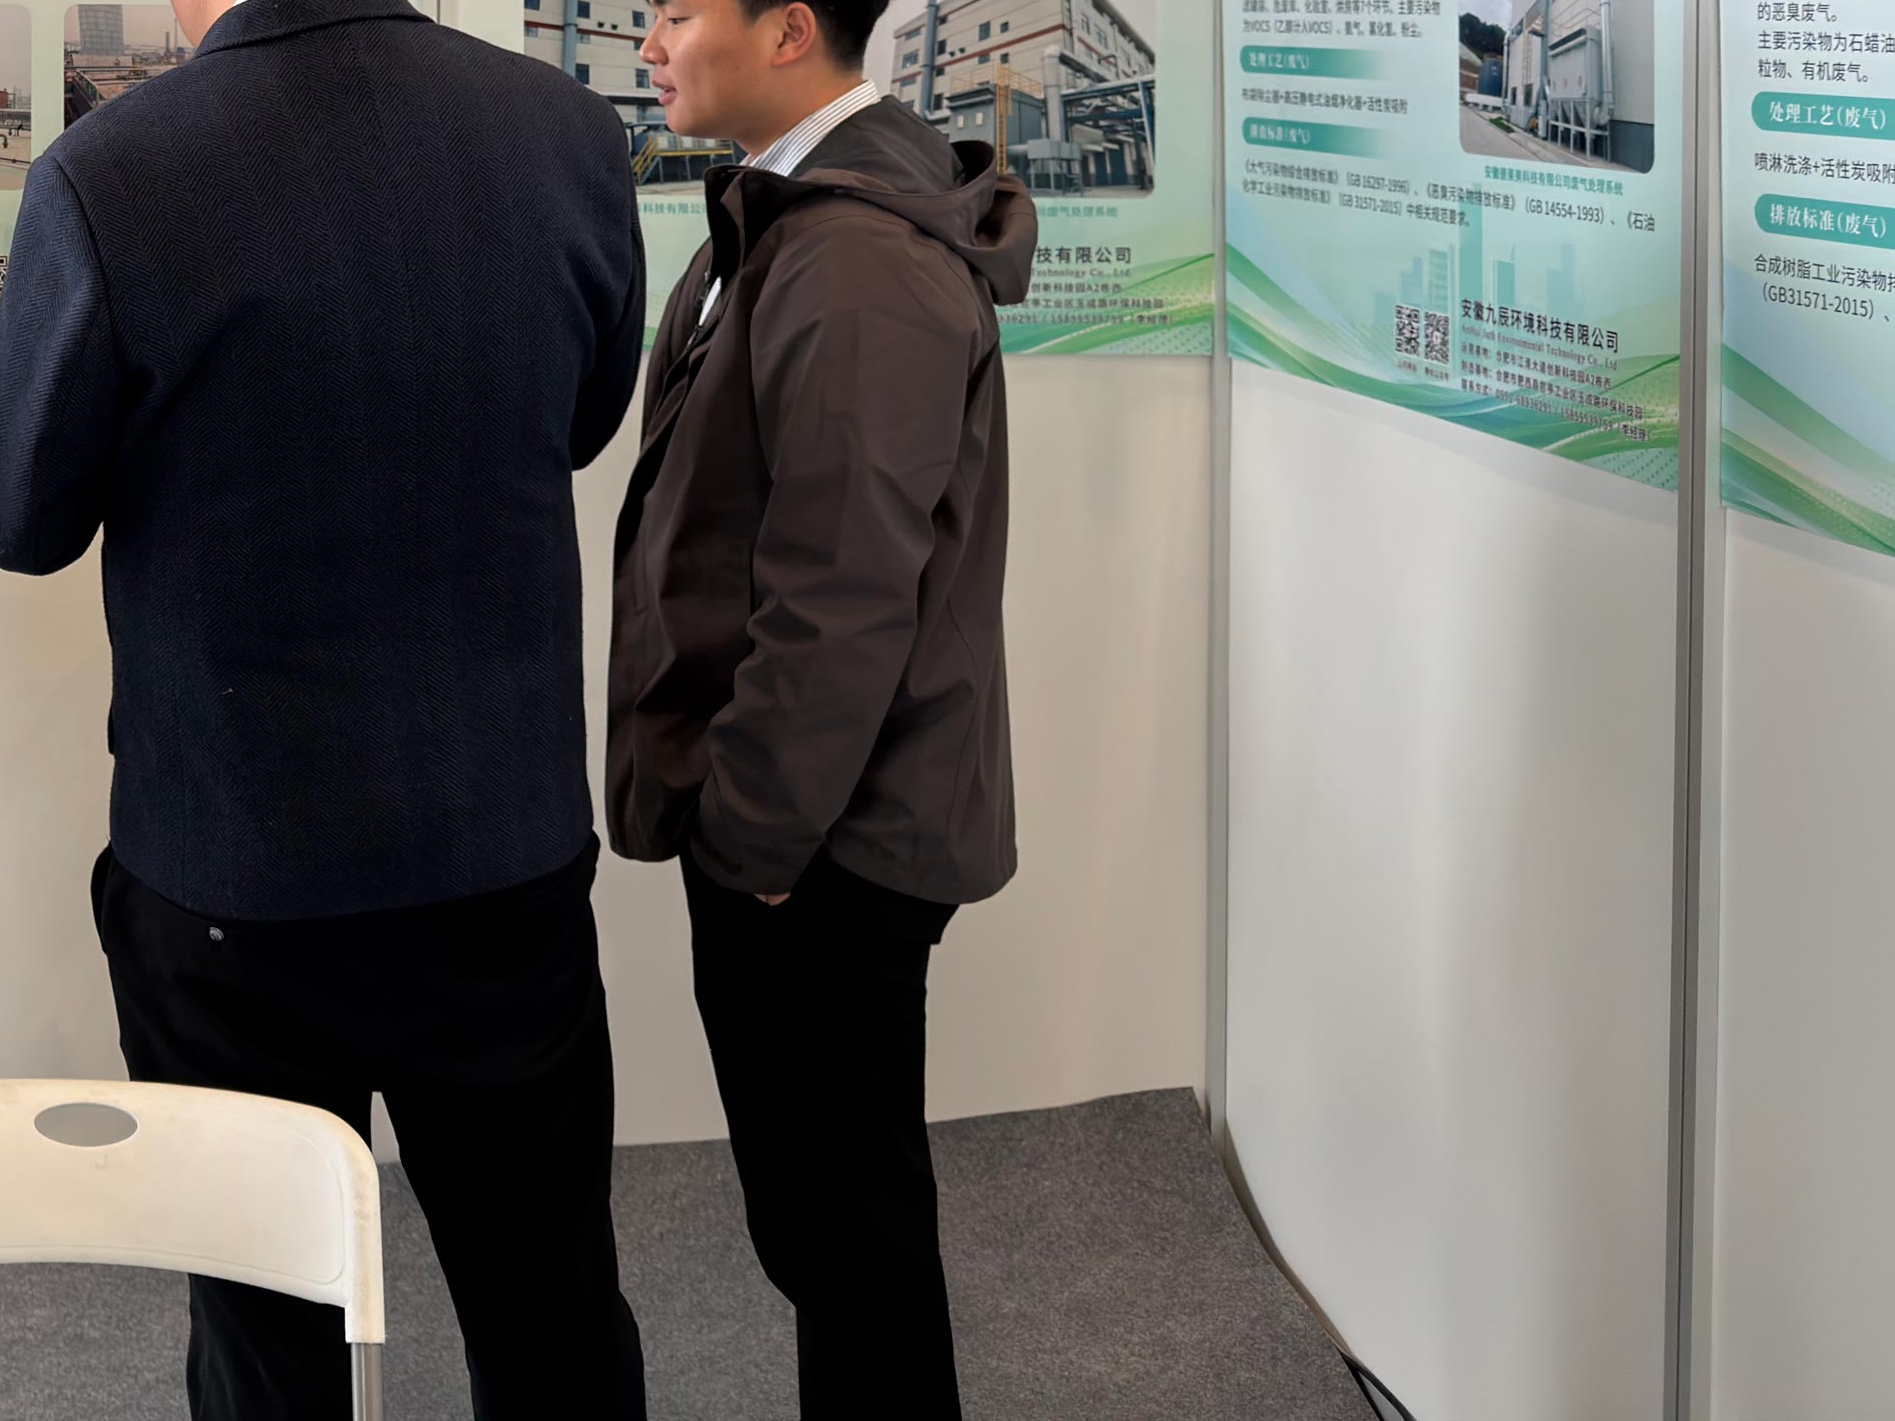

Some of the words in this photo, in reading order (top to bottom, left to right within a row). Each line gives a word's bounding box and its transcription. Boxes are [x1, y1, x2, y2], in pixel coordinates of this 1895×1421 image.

[1757, 2, 1838, 22] 的恶臭废气。
[1758, 29, 1895, 53] 主要污染物为石蜡油
[1758, 58, 1868, 83] 粒物、有机废气。
[1768, 101, 1887, 130] 处理工艺(废气)
[1769, 203, 1887, 239] 排放标准(废气)
[1460, 298, 1619, 354] 安徽九辰环境科技有限公司
